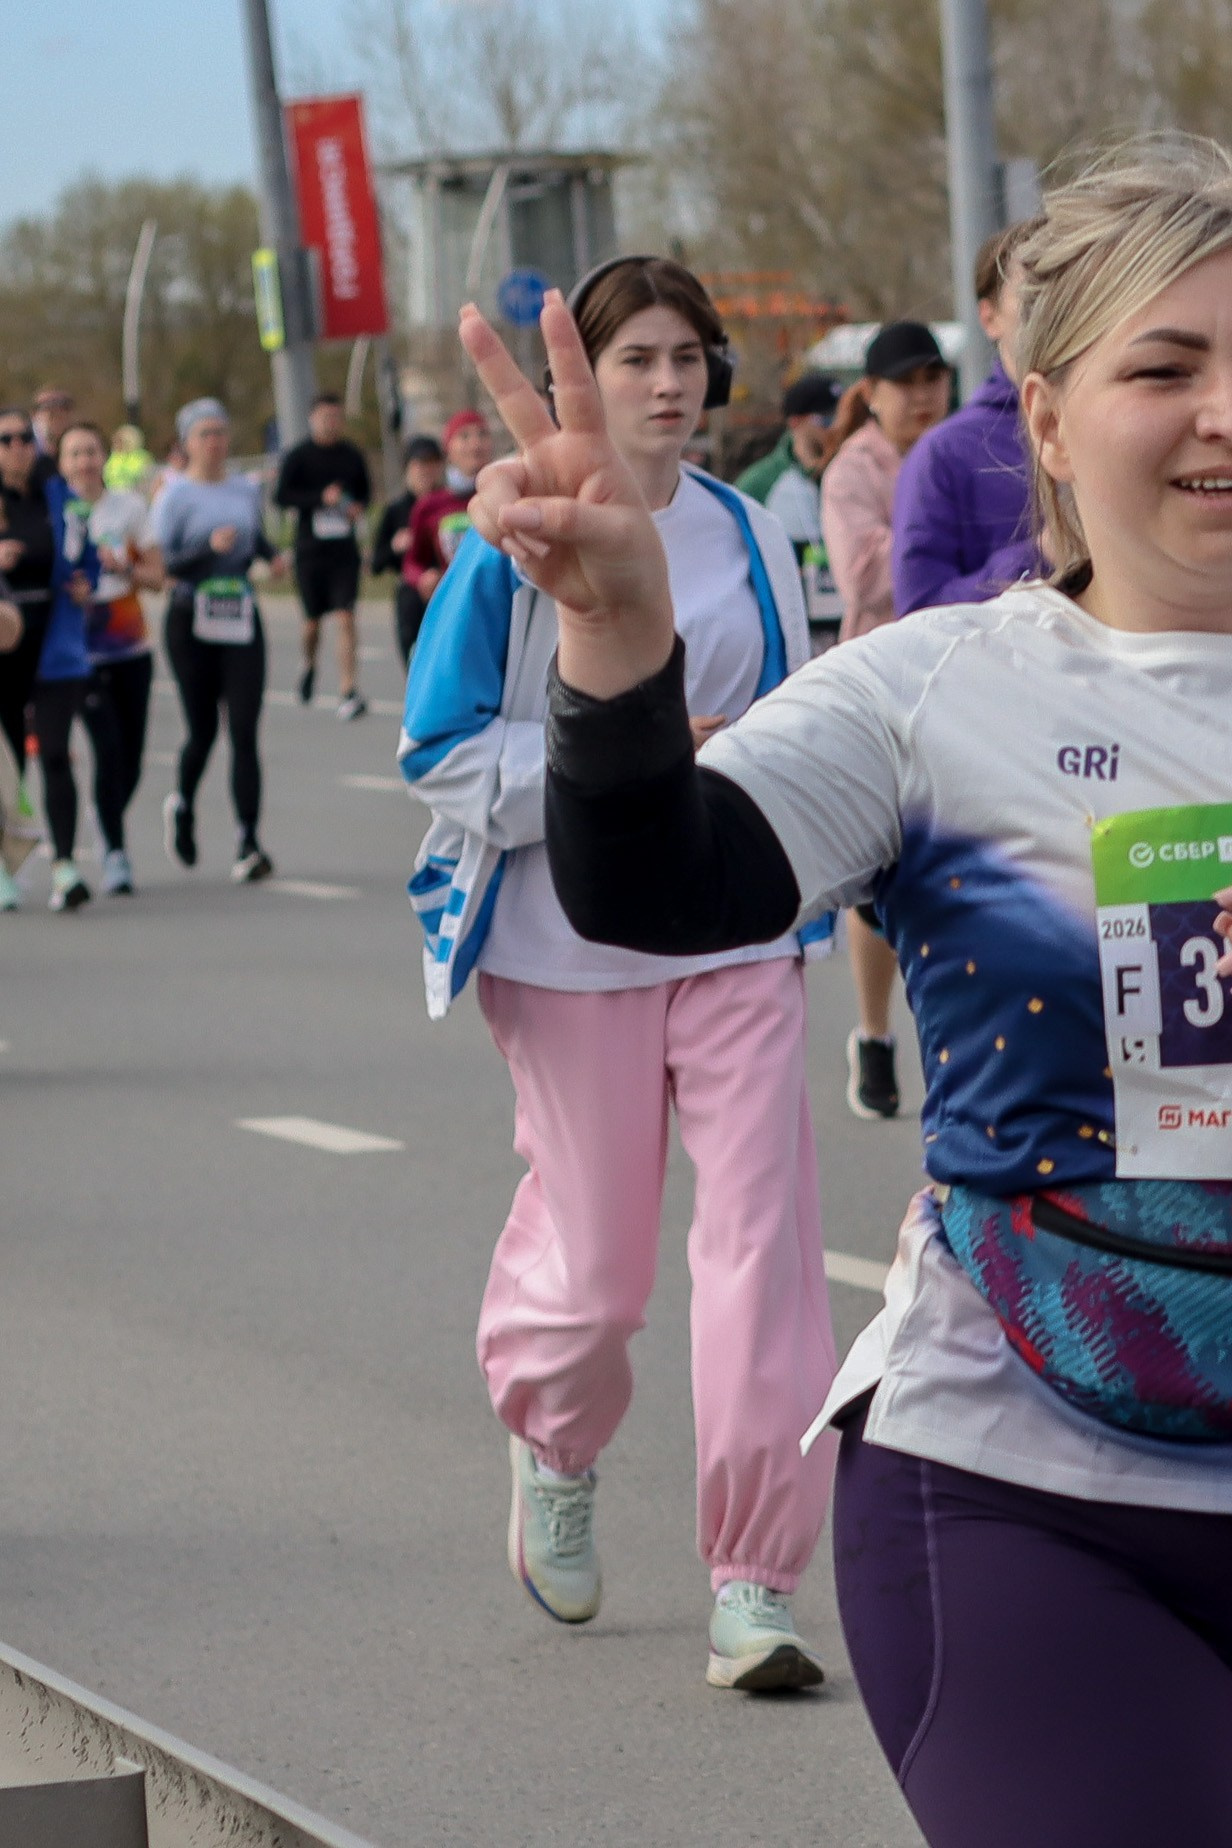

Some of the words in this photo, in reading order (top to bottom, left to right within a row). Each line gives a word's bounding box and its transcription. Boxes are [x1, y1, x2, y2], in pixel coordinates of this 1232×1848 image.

[1057, 743, 1120, 781] GRi
[1158, 841, 1215, 861] СБЕР
[1102, 918, 1146, 940] 2026
[1116, 965, 1142, 1016] F
